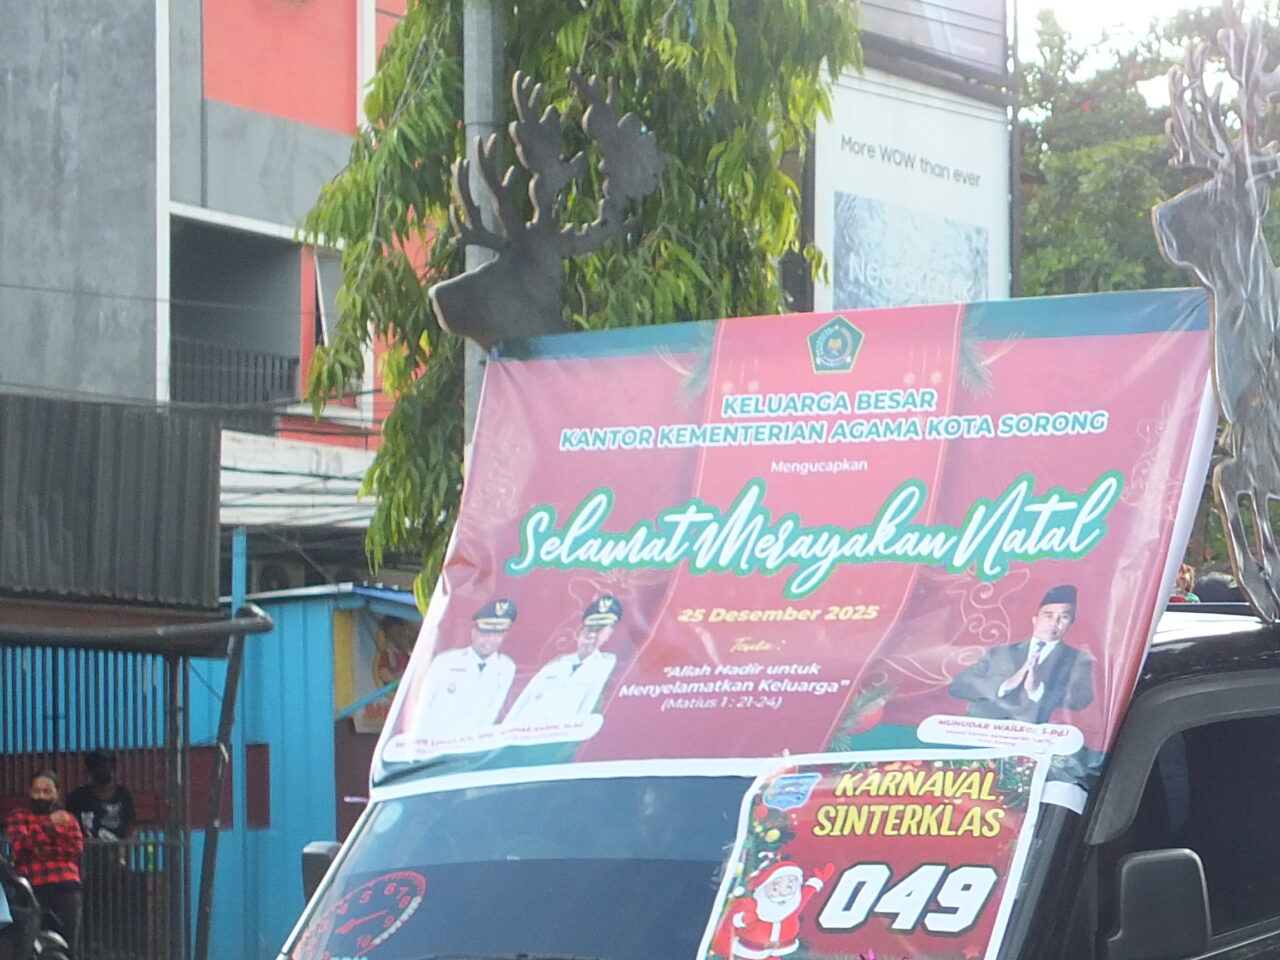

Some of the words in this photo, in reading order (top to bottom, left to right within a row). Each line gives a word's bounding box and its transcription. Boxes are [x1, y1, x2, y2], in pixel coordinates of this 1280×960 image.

[840, 134, 877, 159] More
[879, 144, 917, 169] WOW
[919, 157, 951, 180] than
[952, 168, 982, 188] ever
[721, 392, 851, 417] KELUARGA
[854, 389, 938, 413] BESAR
[559, 427, 655, 451] KANTOR
[657, 420, 826, 449] KEMENTERIAN
[829, 418, 922, 443] AGAMA
[926, 415, 995, 440] KOTA
[997, 410, 1109, 437] SORONG
[771, 458, 868, 475] Mengucapkan
[510, 492, 714, 570] Selamat
[692, 483, 957, 594] Merayakan
[952, 476, 1118, 575] Natal
[677, 608, 705, 622] 25
[708, 607, 822, 624] Desember
[824, 605, 880, 621] 2025
[714, 662, 764, 676] Hadir
[766, 662, 821, 675] untuk
[618, 680, 754, 698] Menyelamatkan
[661, 696, 717, 711] (Matius
[835, 770, 997, 801] KARNAVAL
[812, 803, 1006, 838] SINTERKLAS
[817, 862, 998, 933] 049
